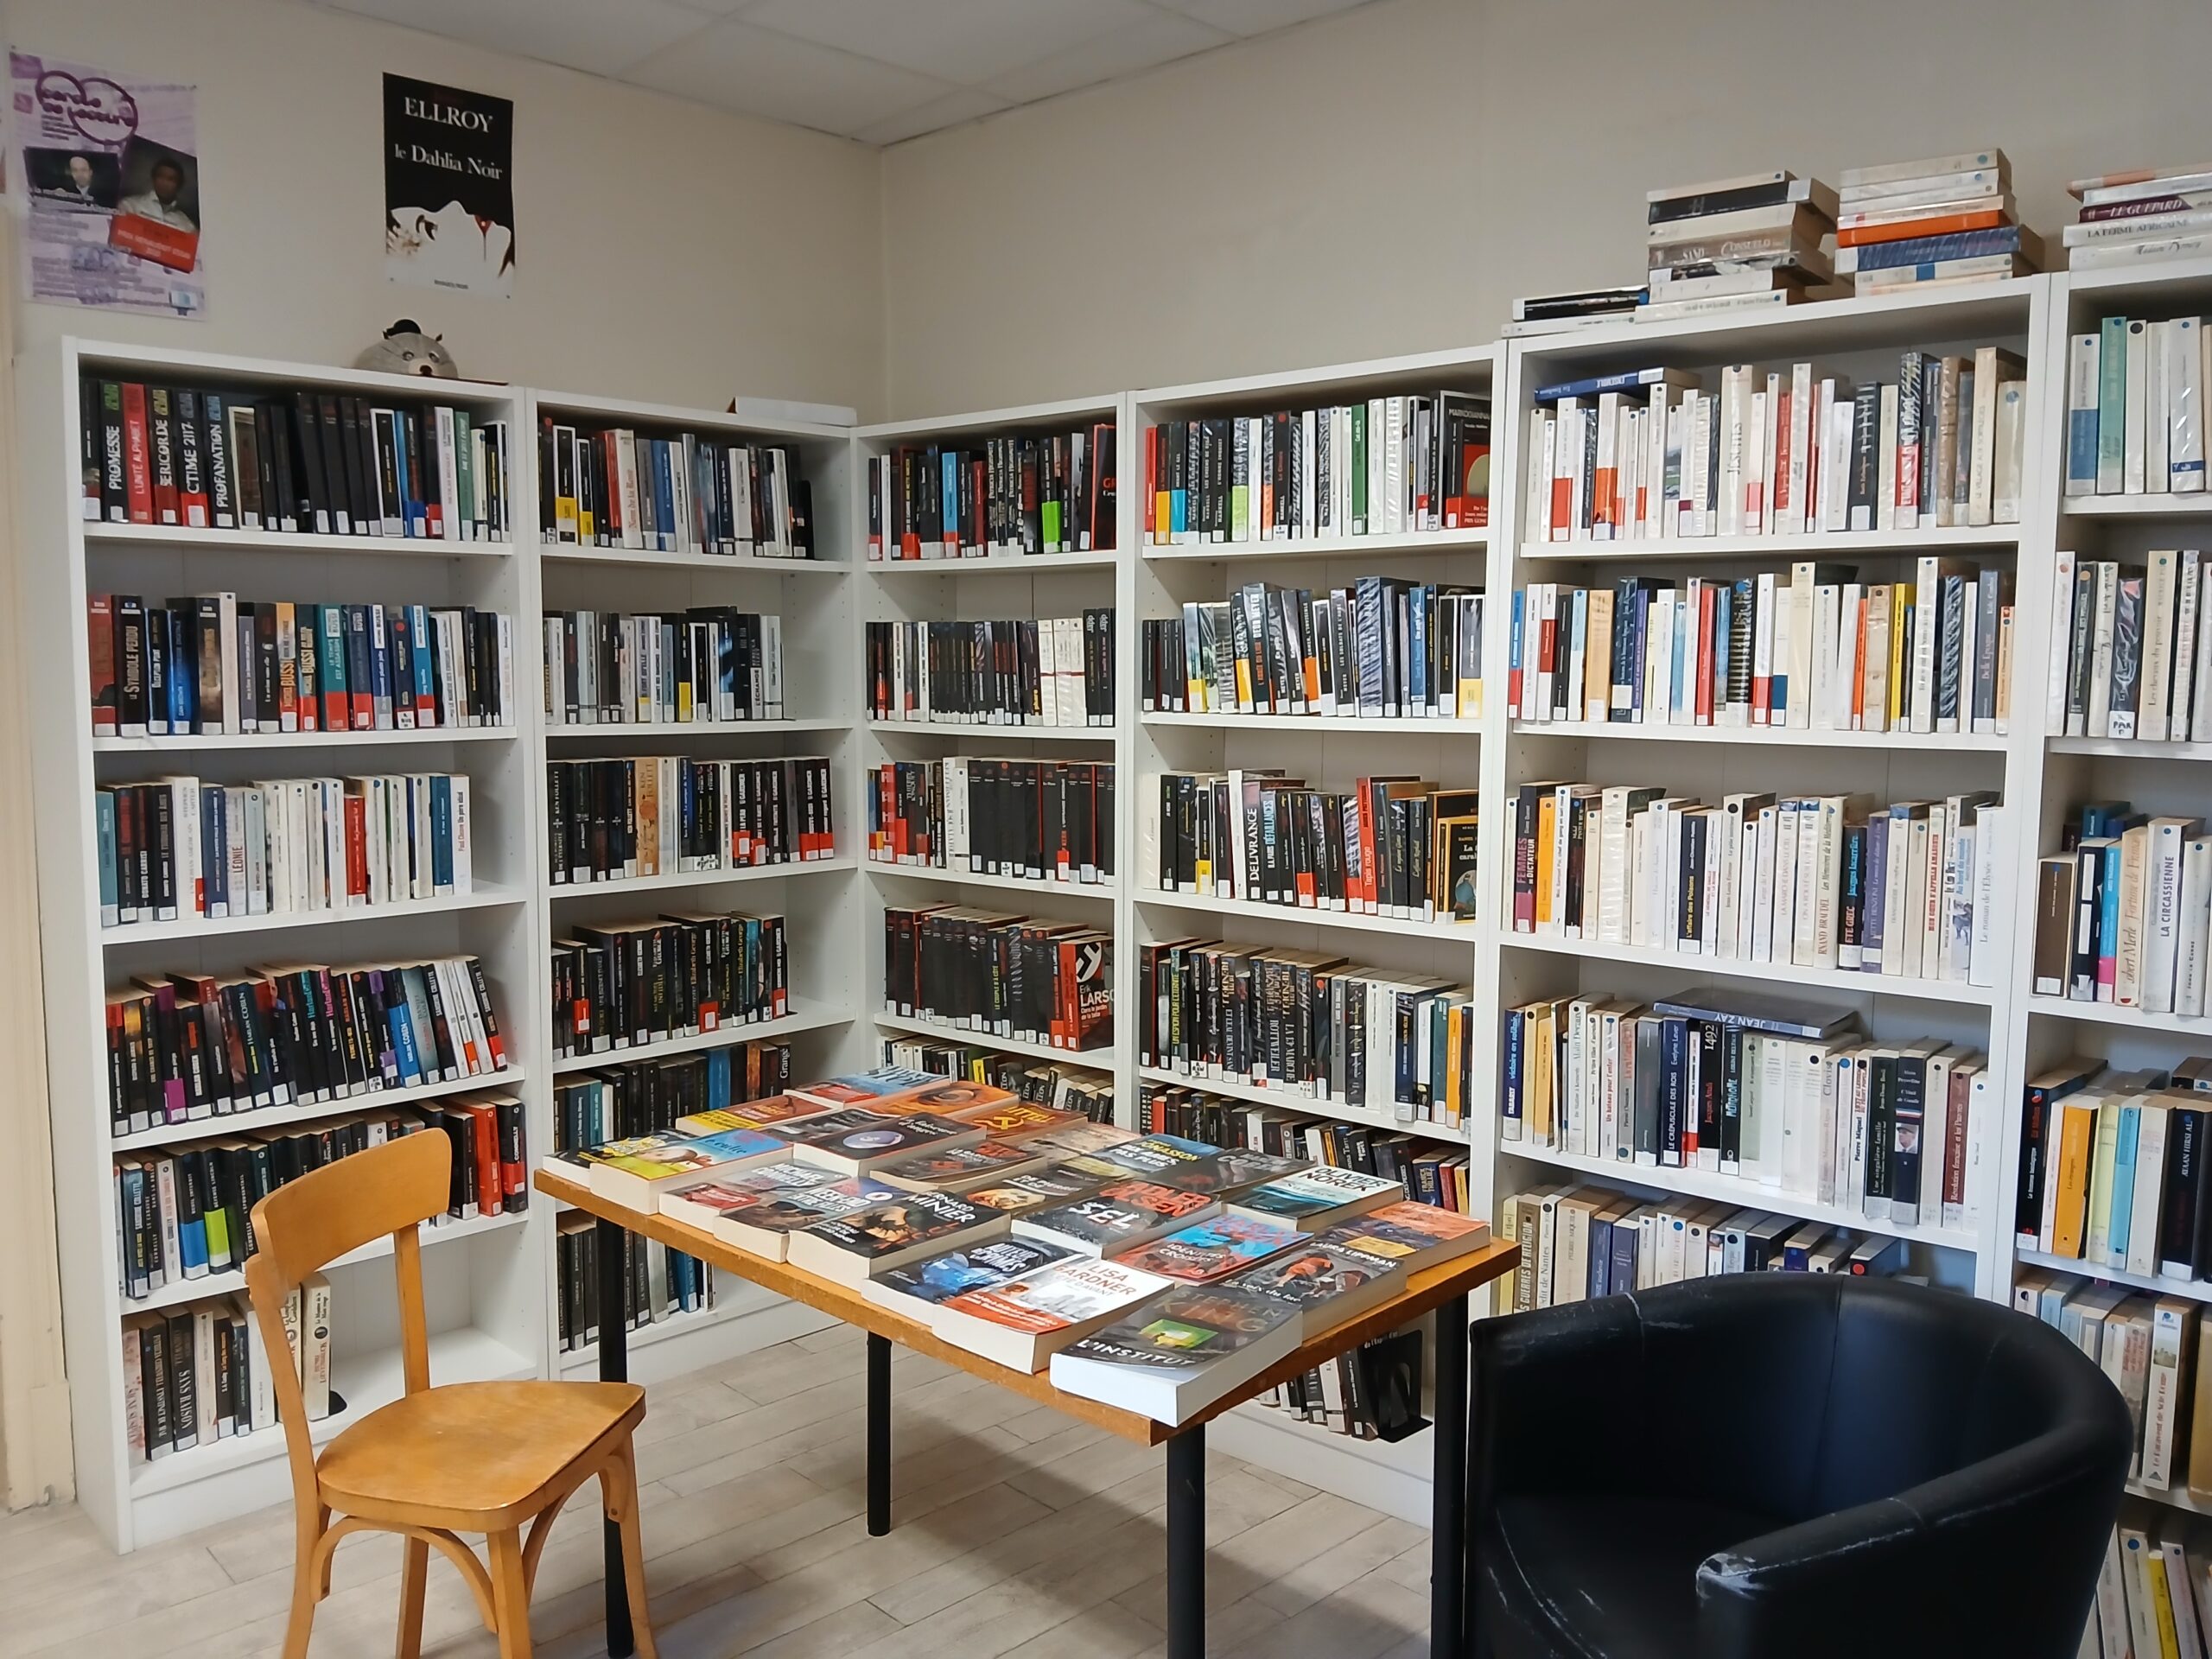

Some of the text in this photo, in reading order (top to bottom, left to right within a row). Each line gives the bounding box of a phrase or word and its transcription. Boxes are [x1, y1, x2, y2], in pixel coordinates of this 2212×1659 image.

[404, 96, 493, 133] ELLROY
[395, 143, 503, 180] le Dahlia Noir
[105, 425, 123, 491] PROMESSE
[181, 421, 200, 494] CTIME 2117
[209, 423, 230, 508] PROFANATION
[626, 469, 634, 490] Rose
[627, 499, 636, 508] de
[628, 511, 637, 528] Nom
[125, 626, 138, 652] PERDU
[2152, 648, 2162, 658] du
[124, 654, 140, 692] SYMBOLE
[301, 649, 315, 673] BUSSI
[2150, 660, 2158, 690] chevaux
[753, 670, 761, 706] L'ÉCHANGE
[2148, 693, 2158, 705] Les
[1263, 800, 1275, 844] DÉFAILLANCES
[1363, 846, 1372, 867] rouge
[1517, 837, 1526, 883] FEMMES
[1957, 861, 1964, 870] du
[1956, 887, 1964, 895] Au
[2160, 855, 2174, 937] LA CIRCASSIENNE
[1818, 899, 1829, 954] RNAND BRAUDEL
[1980, 905, 1989, 930] roman
[1980, 934, 1988, 943] Le
[1080, 985, 1092, 994] Erik
[239, 992, 254, 1045] HARLAN COBEN
[1285, 1024, 1294, 1034] LA
[1714, 1013, 1765, 1030] JEAN ZAY
[402, 1023, 410, 1044] COBEN
[1269, 1020, 1282, 1071] ROTTWEILER
[779, 1048, 790, 1078] Grangé
[1285, 1048, 1296, 1081] MARCHE
[1670, 1040, 1680, 1065] Evelyne
[1704, 1025, 1719, 1124] Jacques Attali 1492
[1822, 1065, 1833, 1096] Clovis
[1037, 1084, 1046, 1101] LEON
[1668, 1102, 1676, 1141] CRÉPUSCULE
[1137, 1154, 1167, 1167] PLUS
[1400, 1165, 1408, 1183] PIERRES
[1873, 1149, 1882, 1178] singulière
[151, 1183, 156, 1192] LA
[1297, 1172, 1375, 1192] NOREK
[1313, 1166, 1389, 1188] OLIVIER
[1420, 1168, 1428, 1192] FRANCK
[1121, 1180, 1212, 1206] ADLER
[907, 1194, 976, 1224] MINIER
[1069, 1199, 1141, 1230] SEL
[245, 1222, 254, 1251] CONNELLY
[1310, 1241, 1398, 1269] LAURA LIPPMAN
[1520, 1222, 1533, 1303] GUERRES DE RELIGION
[1053, 1265, 1137, 1295] GARDNER
[1088, 1264, 1130, 1282] LISA
[1154, 1300, 1268, 1332] KING
[1176, 1288, 1284, 1319] STEPHEN
[1077, 1338, 1197, 1367] L'INSTITUT
[178, 1370, 194, 1429] SANS RAISON
